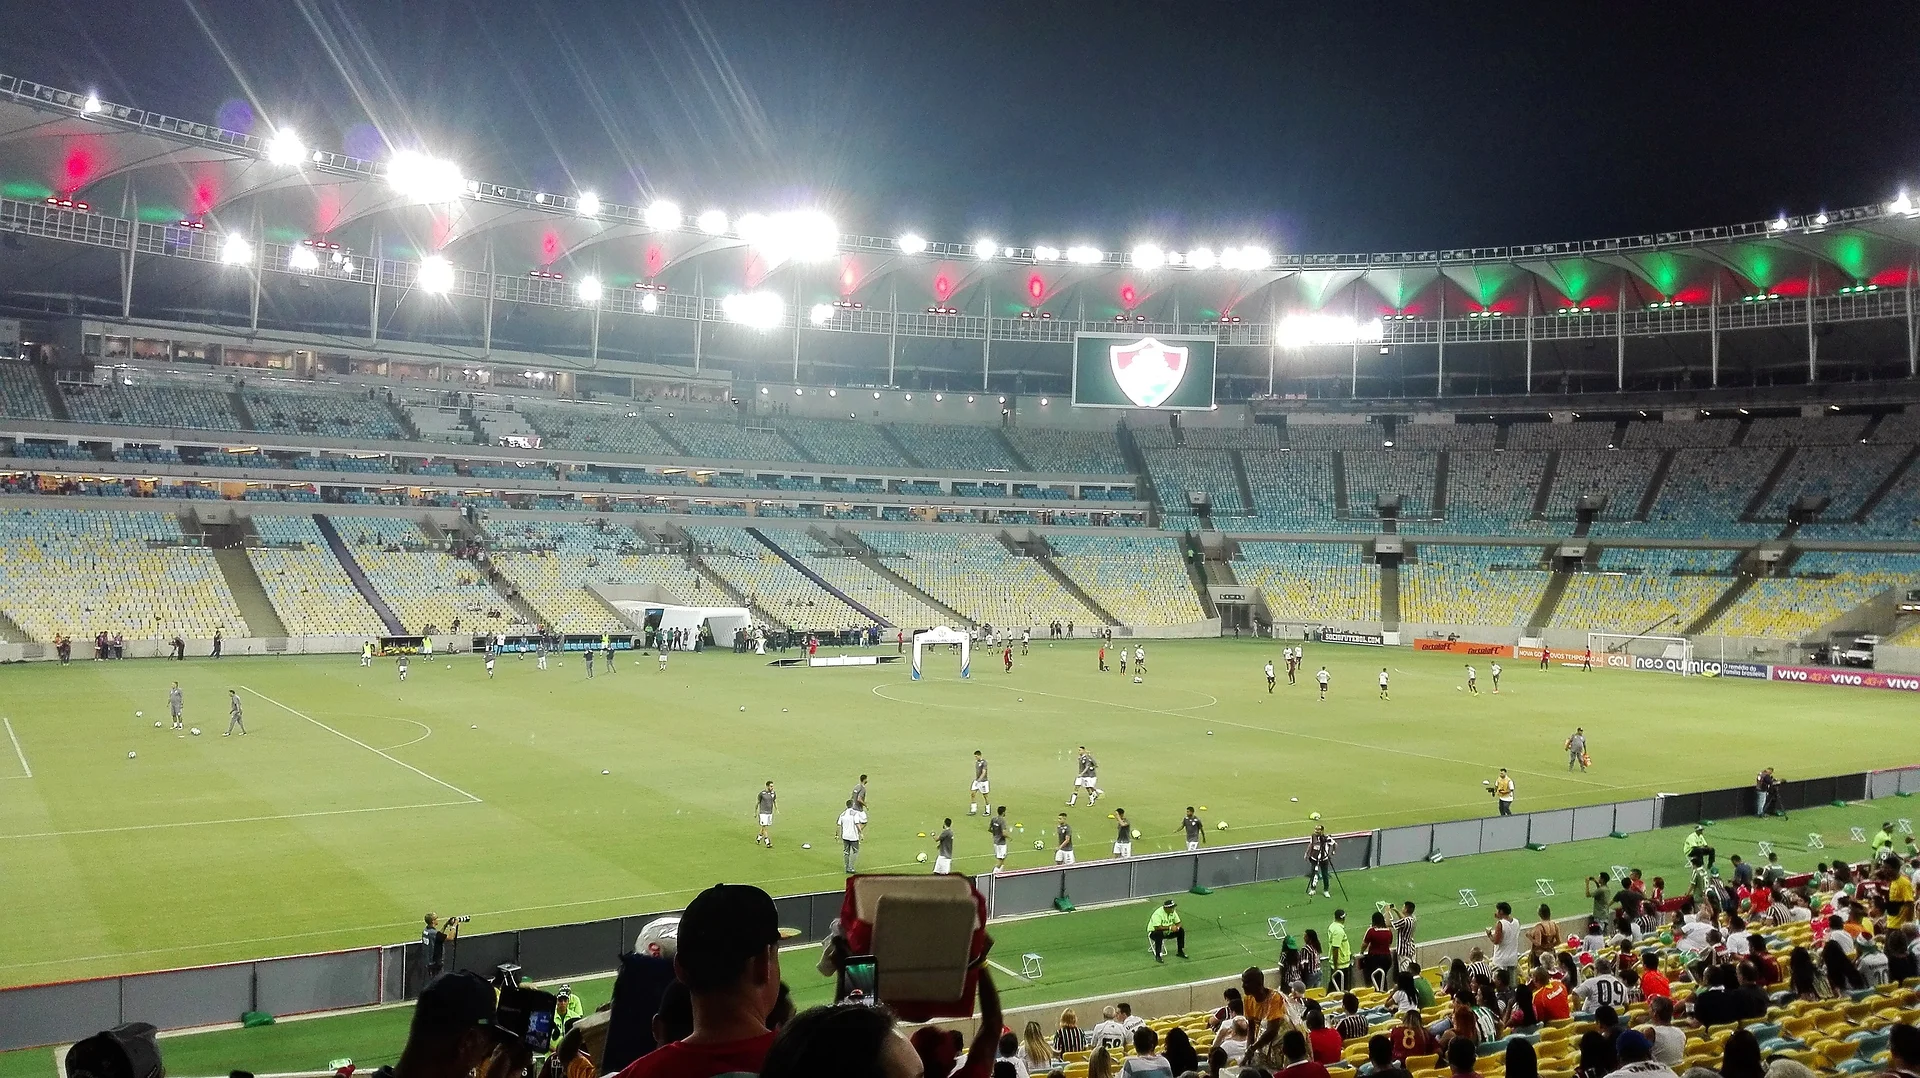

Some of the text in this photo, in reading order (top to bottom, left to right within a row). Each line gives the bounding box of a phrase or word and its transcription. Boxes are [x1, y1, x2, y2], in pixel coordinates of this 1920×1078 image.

[1607, 655, 1630, 667] GOL
[1636, 657, 1664, 670] neo
[1596, 979, 1624, 1007] 09
[1402, 1028, 1416, 1050] 8
